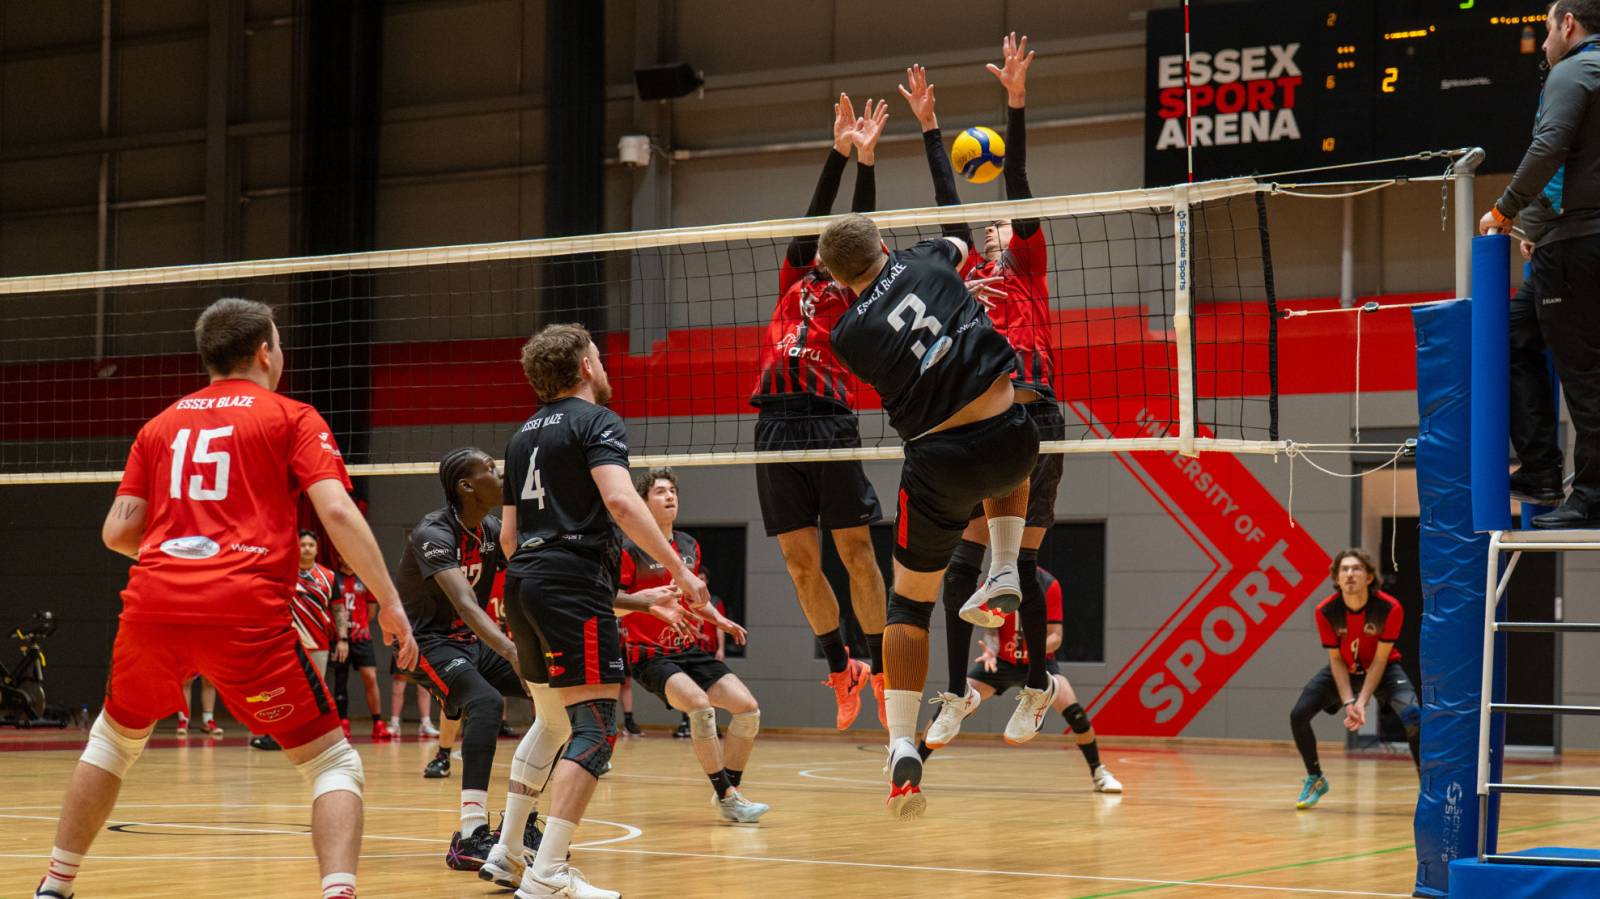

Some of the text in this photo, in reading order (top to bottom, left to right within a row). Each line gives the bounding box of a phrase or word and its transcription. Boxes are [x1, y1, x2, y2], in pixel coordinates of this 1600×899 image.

[1158, 42, 1302, 88] ESSEX
[1382, 67, 1399, 93] 2
[1157, 75, 1303, 119] SPORT
[1156, 108, 1301, 150] ARENA
[880, 262, 907, 291] BLAZE
[1178, 220, 1188, 290] Schelde Sports
[887, 292, 943, 361] 3
[176, 395, 256, 410] ESSEX BLAZE
[169, 425, 234, 500] 15
[520, 446, 546, 510] 4
[1136, 408, 1265, 543] UNERSITY OF
[1139, 538, 1304, 725] SPORT
[1350, 637, 1360, 660] 9
